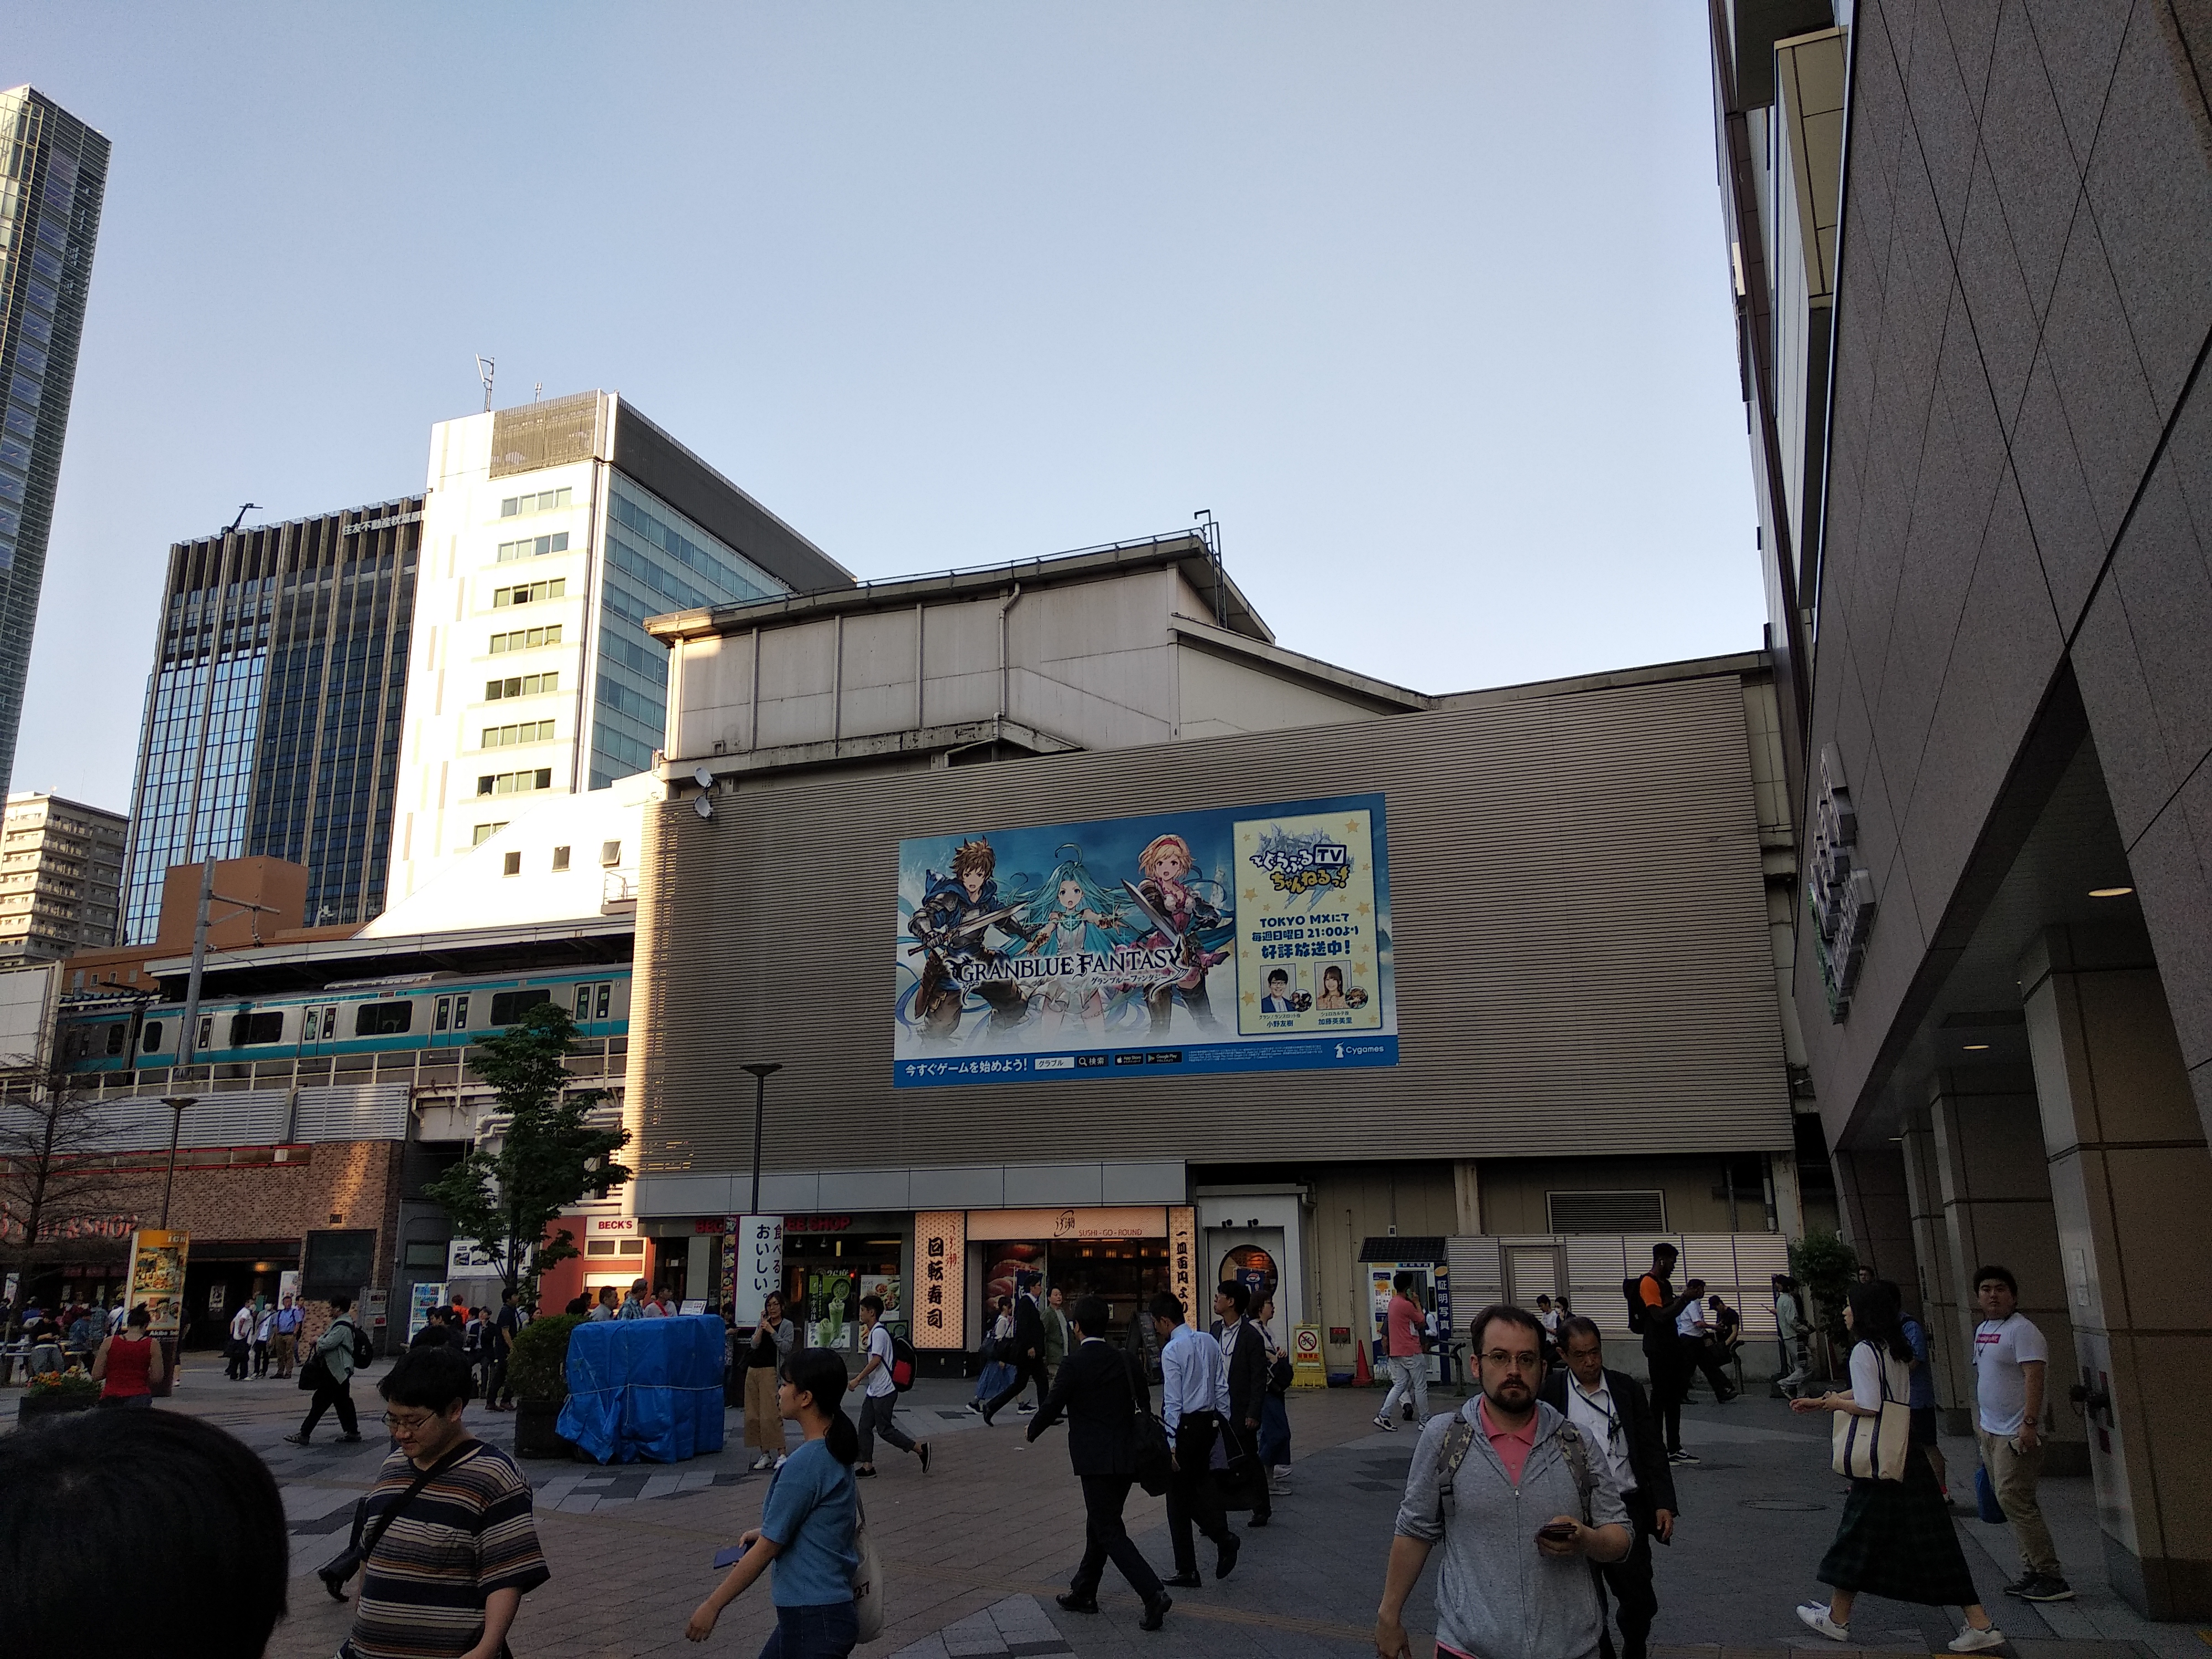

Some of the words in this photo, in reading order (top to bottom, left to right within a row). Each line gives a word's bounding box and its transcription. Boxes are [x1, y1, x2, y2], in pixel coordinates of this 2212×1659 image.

[342, 511, 422, 535] 住友不動産秋葉原
[1260, 916, 1305, 928] TOKYO
[1252, 929, 1303, 942] 毎週日曜日
[1261, 940, 1350, 959] 好評放送中!
[945, 955, 1074, 987] GRANBLUE
[1073, 937, 1188, 982] FANTASY
[1091, 975, 1167, 985] グランブルーファンタジー
[1345, 1046, 1384, 1056] Cygames
[905, 1058, 1027, 1077] 今すぐゲームを始めよう!
[1038, 1060, 1064, 1068] グラブル
[1089, 1057, 1105, 1066] 検索
[598, 1220, 633, 1229] BECK'S
[696, 1219, 724, 1233] BEC
[808, 1216, 852, 1230] SHOP
[754, 1224, 770, 1298] おいしい。
[927, 1237, 944, 1329] 回転寿司
[1437, 1280, 1450, 1331] 証明写真
